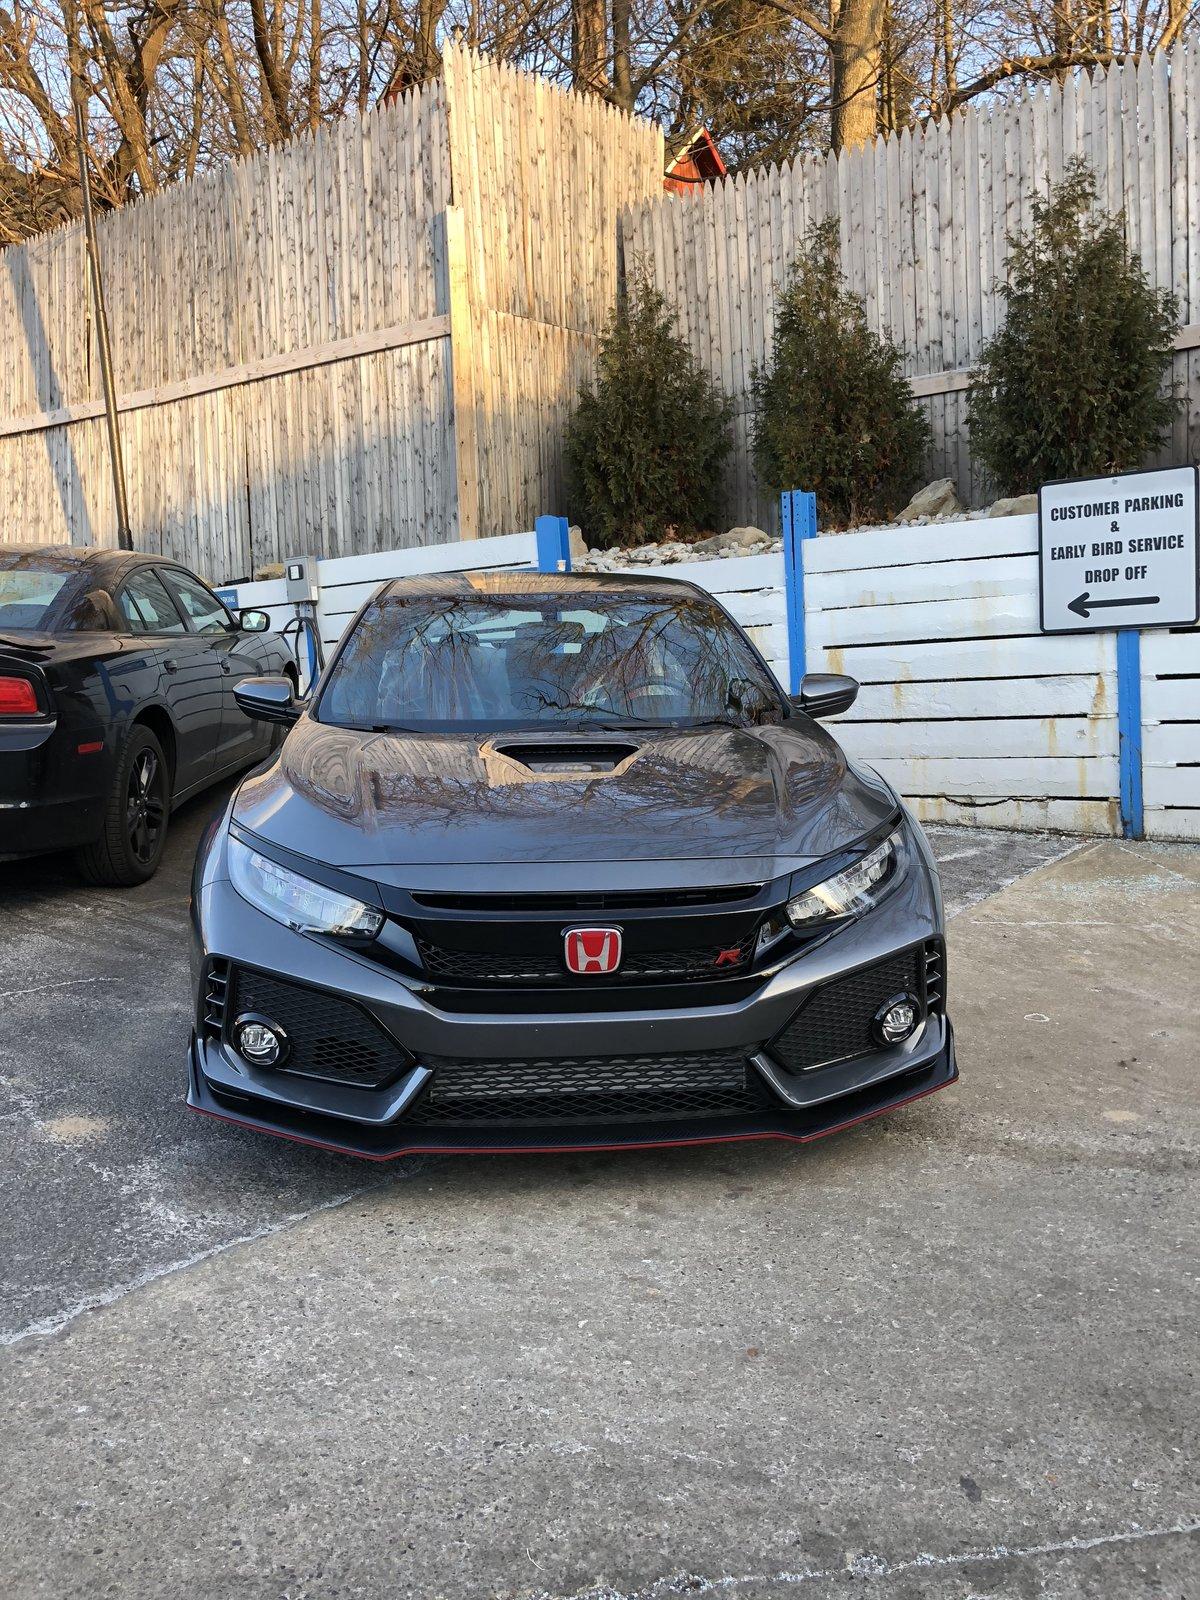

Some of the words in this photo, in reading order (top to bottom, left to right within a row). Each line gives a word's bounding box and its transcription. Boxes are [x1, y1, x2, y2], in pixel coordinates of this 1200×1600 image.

[1051, 501, 1119, 521] CUSTOMER
[1125, 493, 1183, 513] PARKING
[1110, 521, 1120, 532] &
[1051, 544, 1086, 560] EARLY
[1092, 541, 1122, 556] BIRD
[1128, 535, 1184, 553] SERVICE
[1085, 568, 1119, 583] DROP
[1125, 565, 1147, 580] OFF
